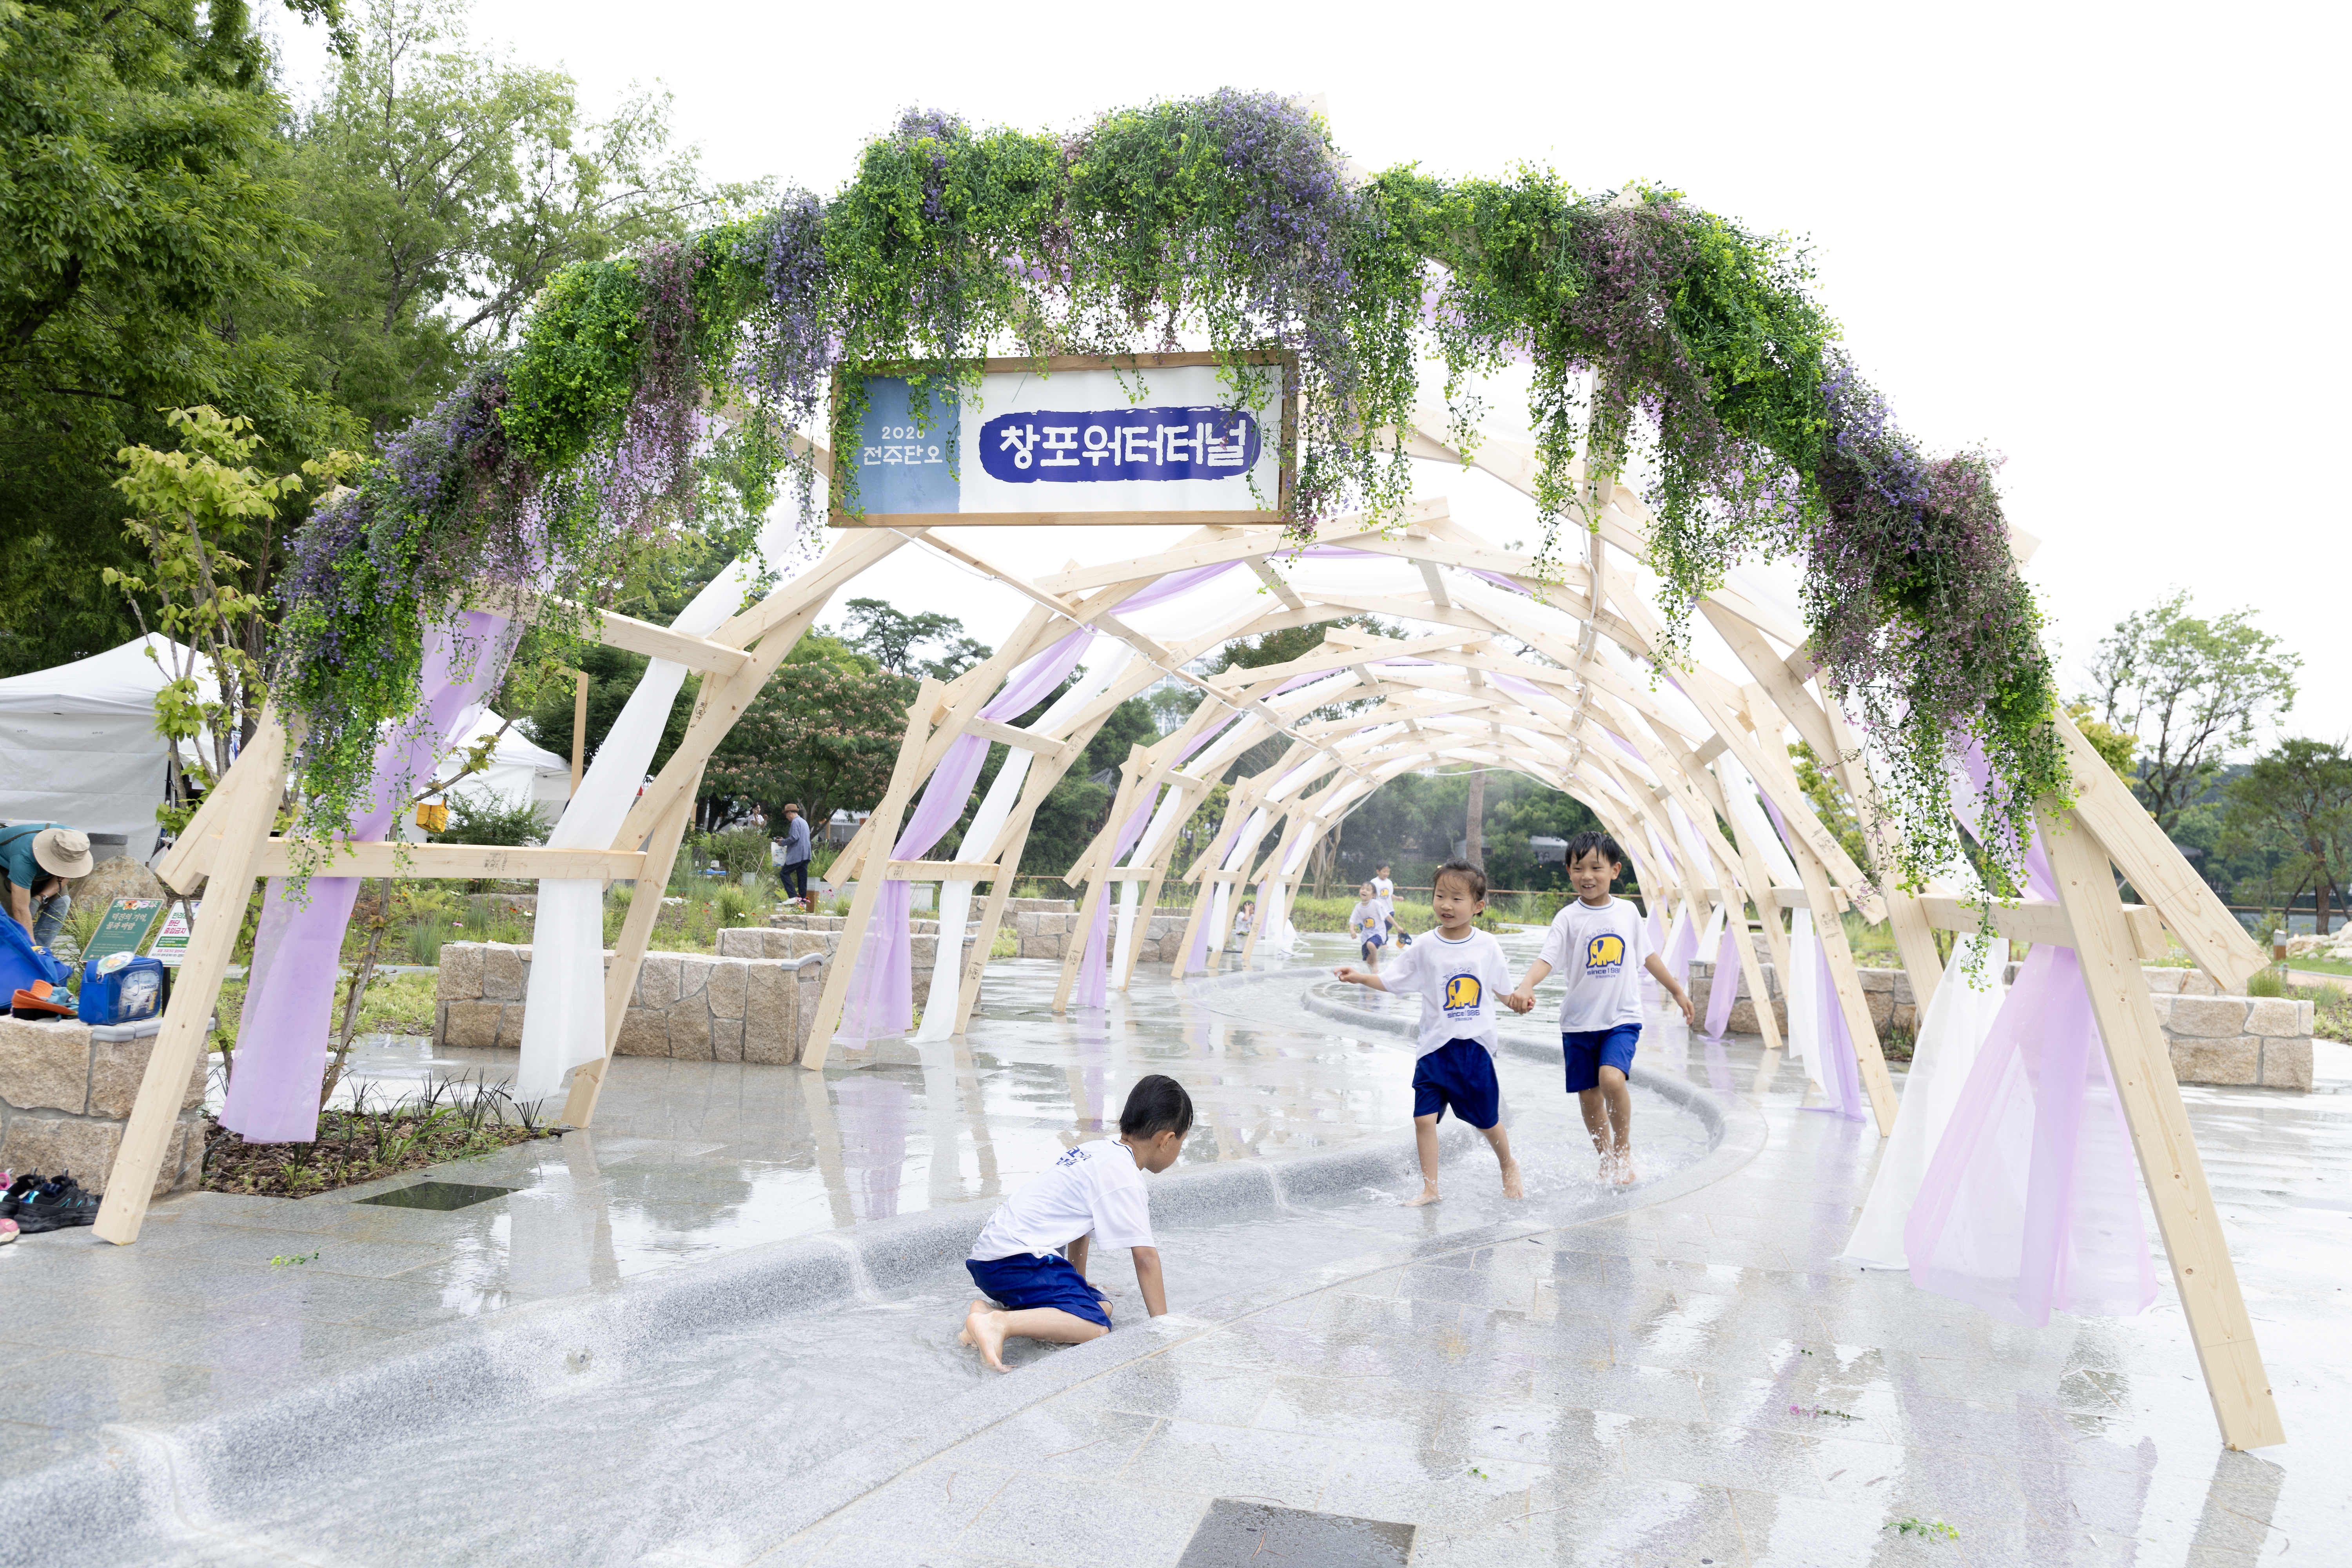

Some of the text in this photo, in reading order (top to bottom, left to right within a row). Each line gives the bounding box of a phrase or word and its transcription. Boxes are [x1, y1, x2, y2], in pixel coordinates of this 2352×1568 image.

[999, 419, 1247, 469] 창포워터터널
[864, 445, 943, 465] 전주단오
[112, 913, 132, 921] 덕진의
[121, 922, 136, 930] 바람
